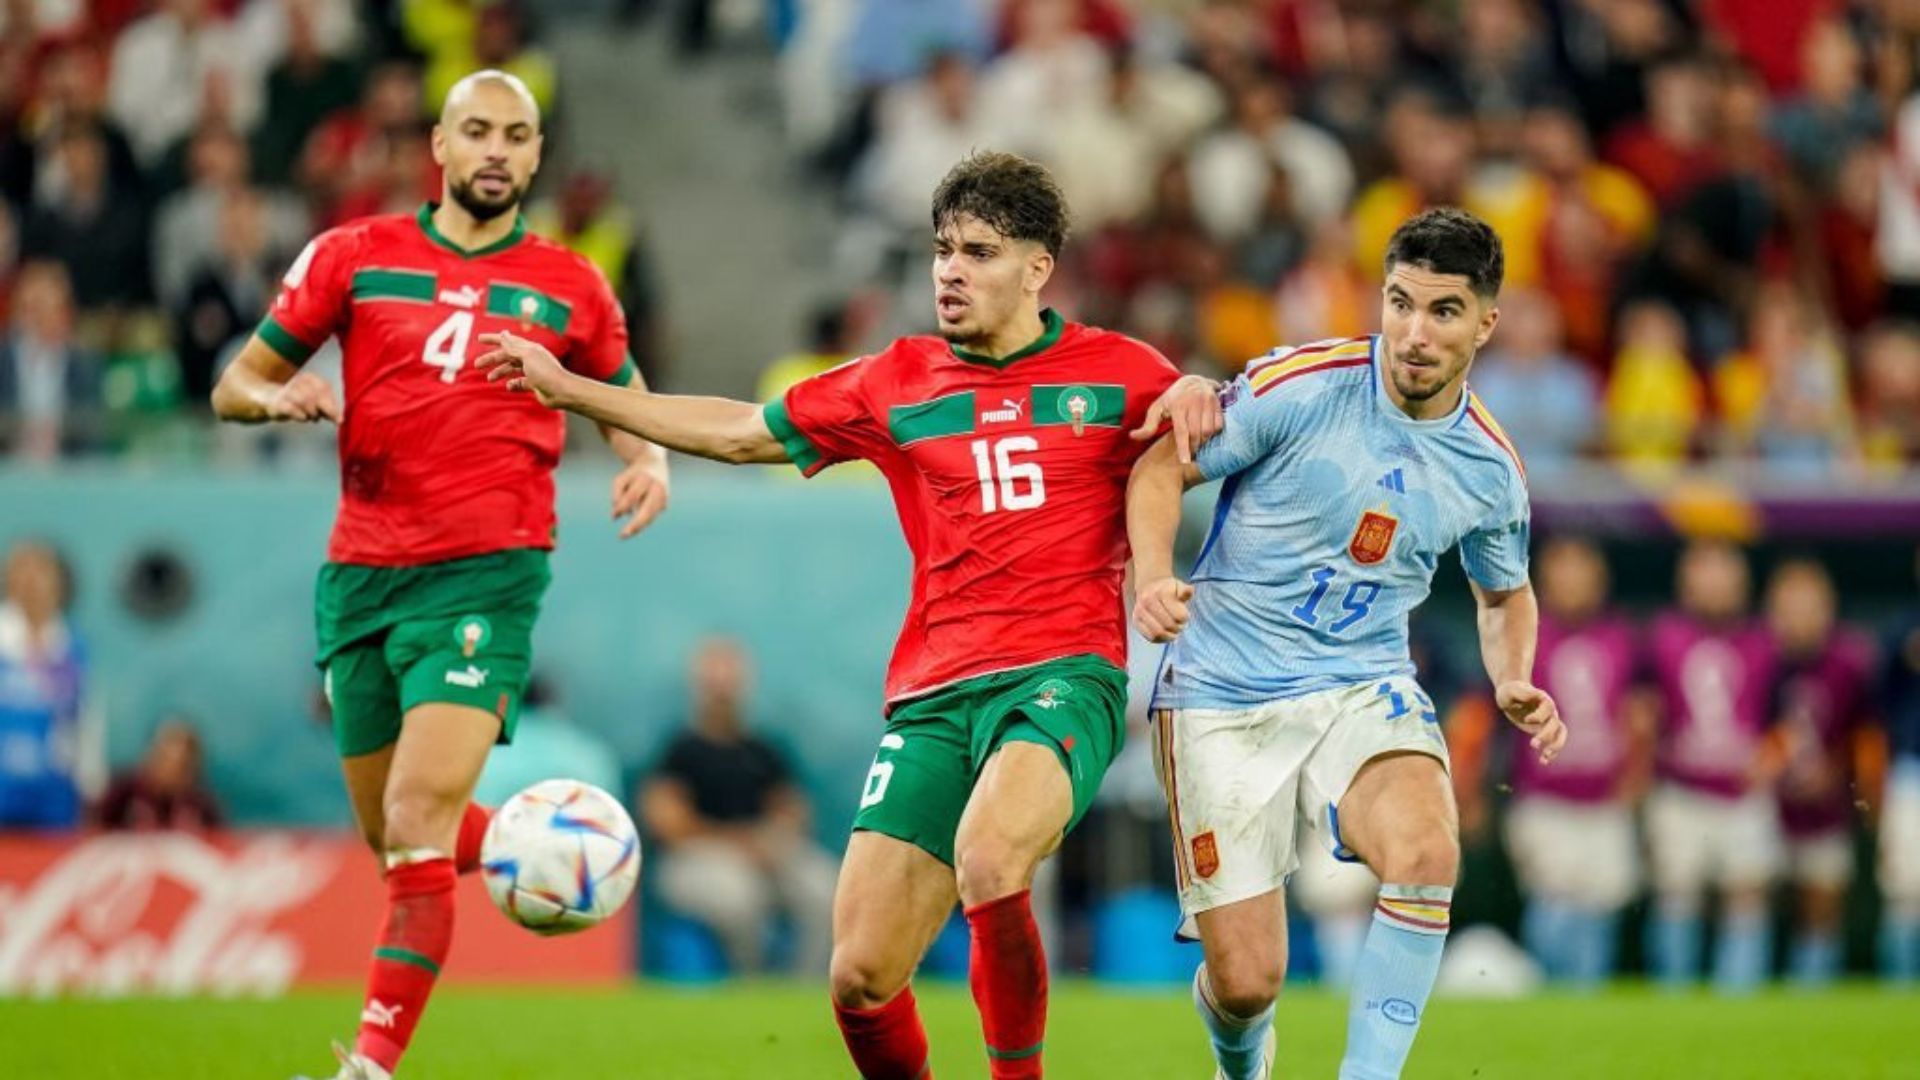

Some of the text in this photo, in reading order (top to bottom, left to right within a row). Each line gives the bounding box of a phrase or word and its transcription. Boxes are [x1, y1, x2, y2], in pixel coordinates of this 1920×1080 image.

[422, 310, 475, 384] 4
[982, 409, 1017, 424] PUMA
[970, 435, 1047, 513] 16
[1290, 565, 1382, 635] 19
